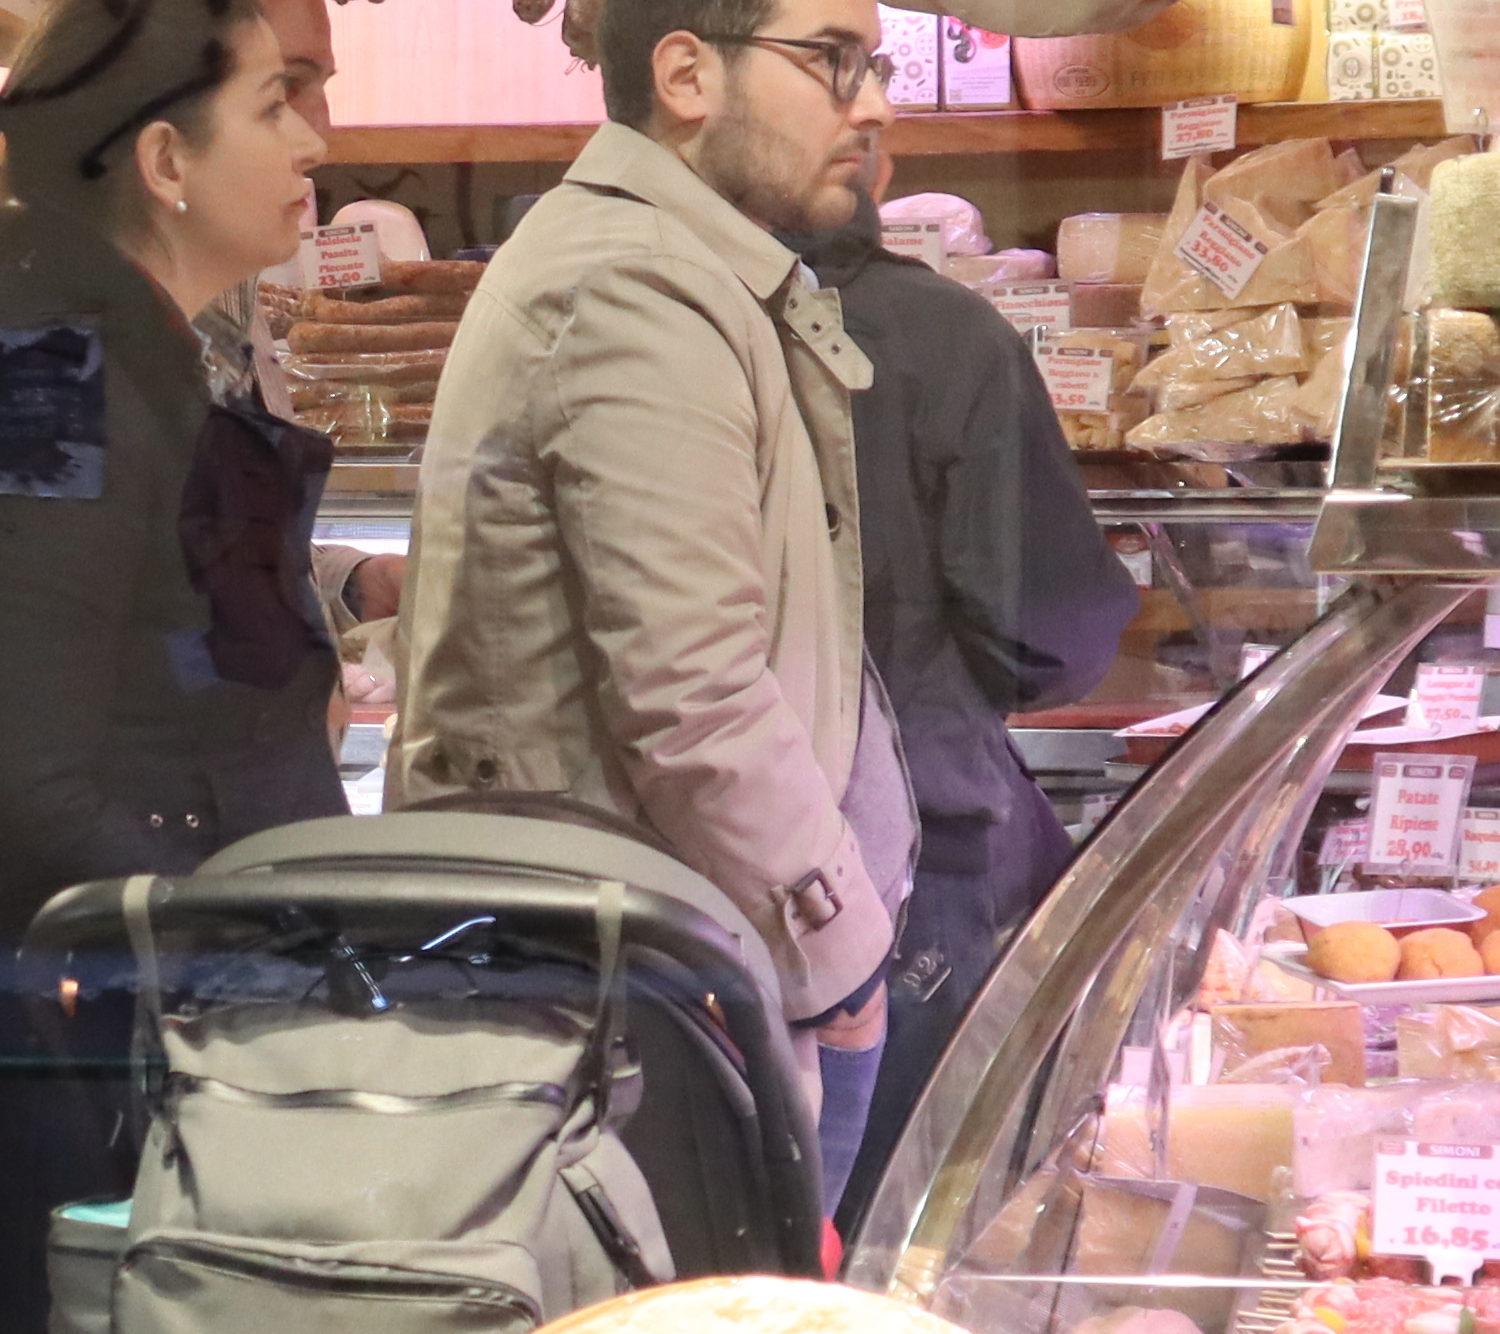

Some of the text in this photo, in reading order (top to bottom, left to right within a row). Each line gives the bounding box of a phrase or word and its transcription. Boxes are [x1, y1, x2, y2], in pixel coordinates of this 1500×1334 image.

[1202, 214, 1257, 260] Parmigiano
[1199, 230, 1243, 268] Reggiano
[1398, 789, 1439, 805] Patate
[1390, 814, 1439, 831] Ripiene
[1430, 1145, 1482, 1159] SIMONI
[1386, 1171, 1478, 1193] Spiedini
[1415, 1197, 1492, 1216] Filetto
[1402, 1225, 1491, 1251] 16,85
